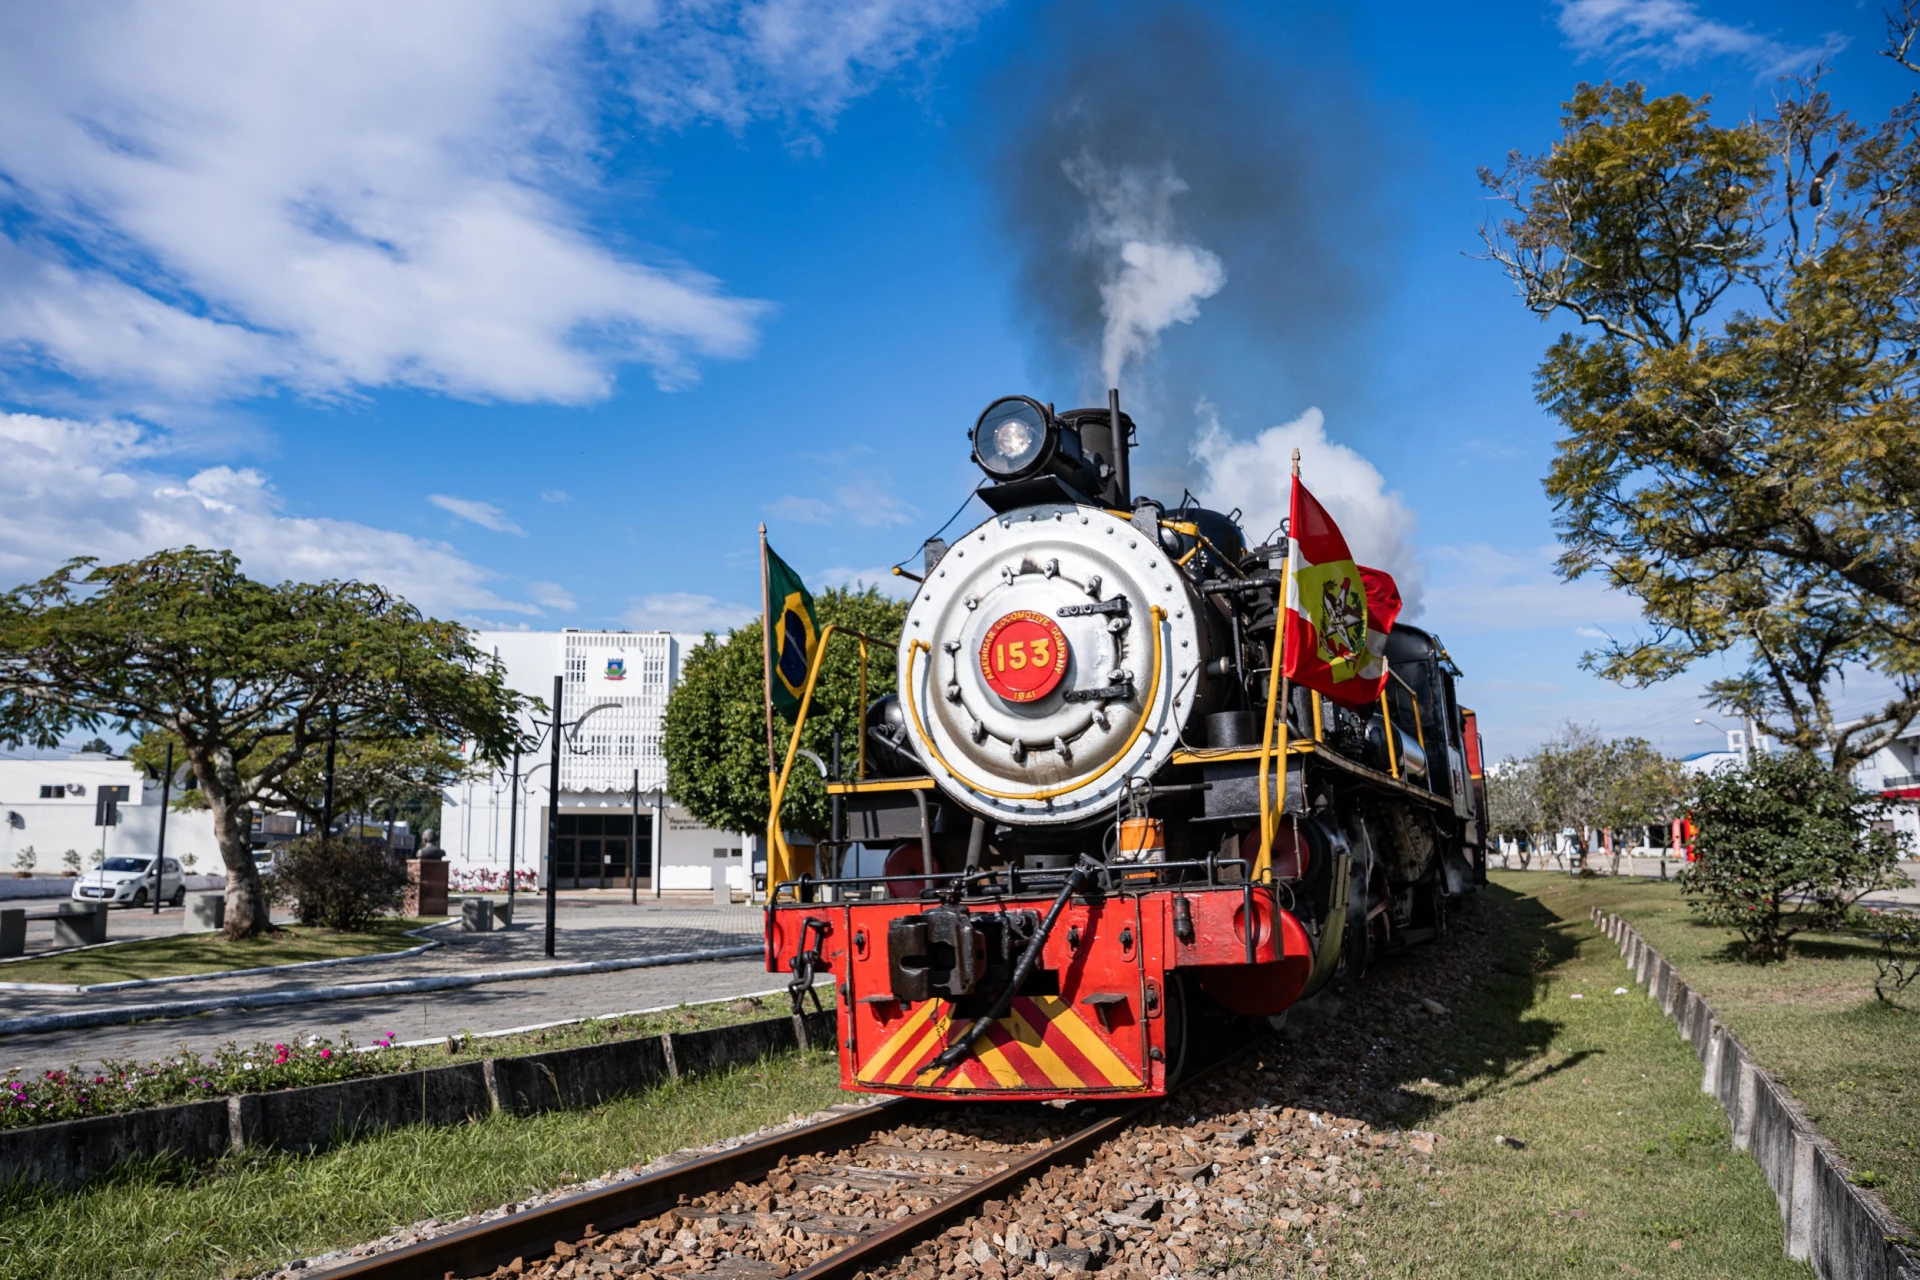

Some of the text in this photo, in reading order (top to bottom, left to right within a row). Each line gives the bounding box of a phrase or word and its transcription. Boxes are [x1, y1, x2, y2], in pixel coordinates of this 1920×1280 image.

[981, 611, 1066, 680] AMERICAN LOCOMOTIVE COMPANY
[997, 638, 1050, 672] 153
[1014, 690, 1036, 700] 1941
